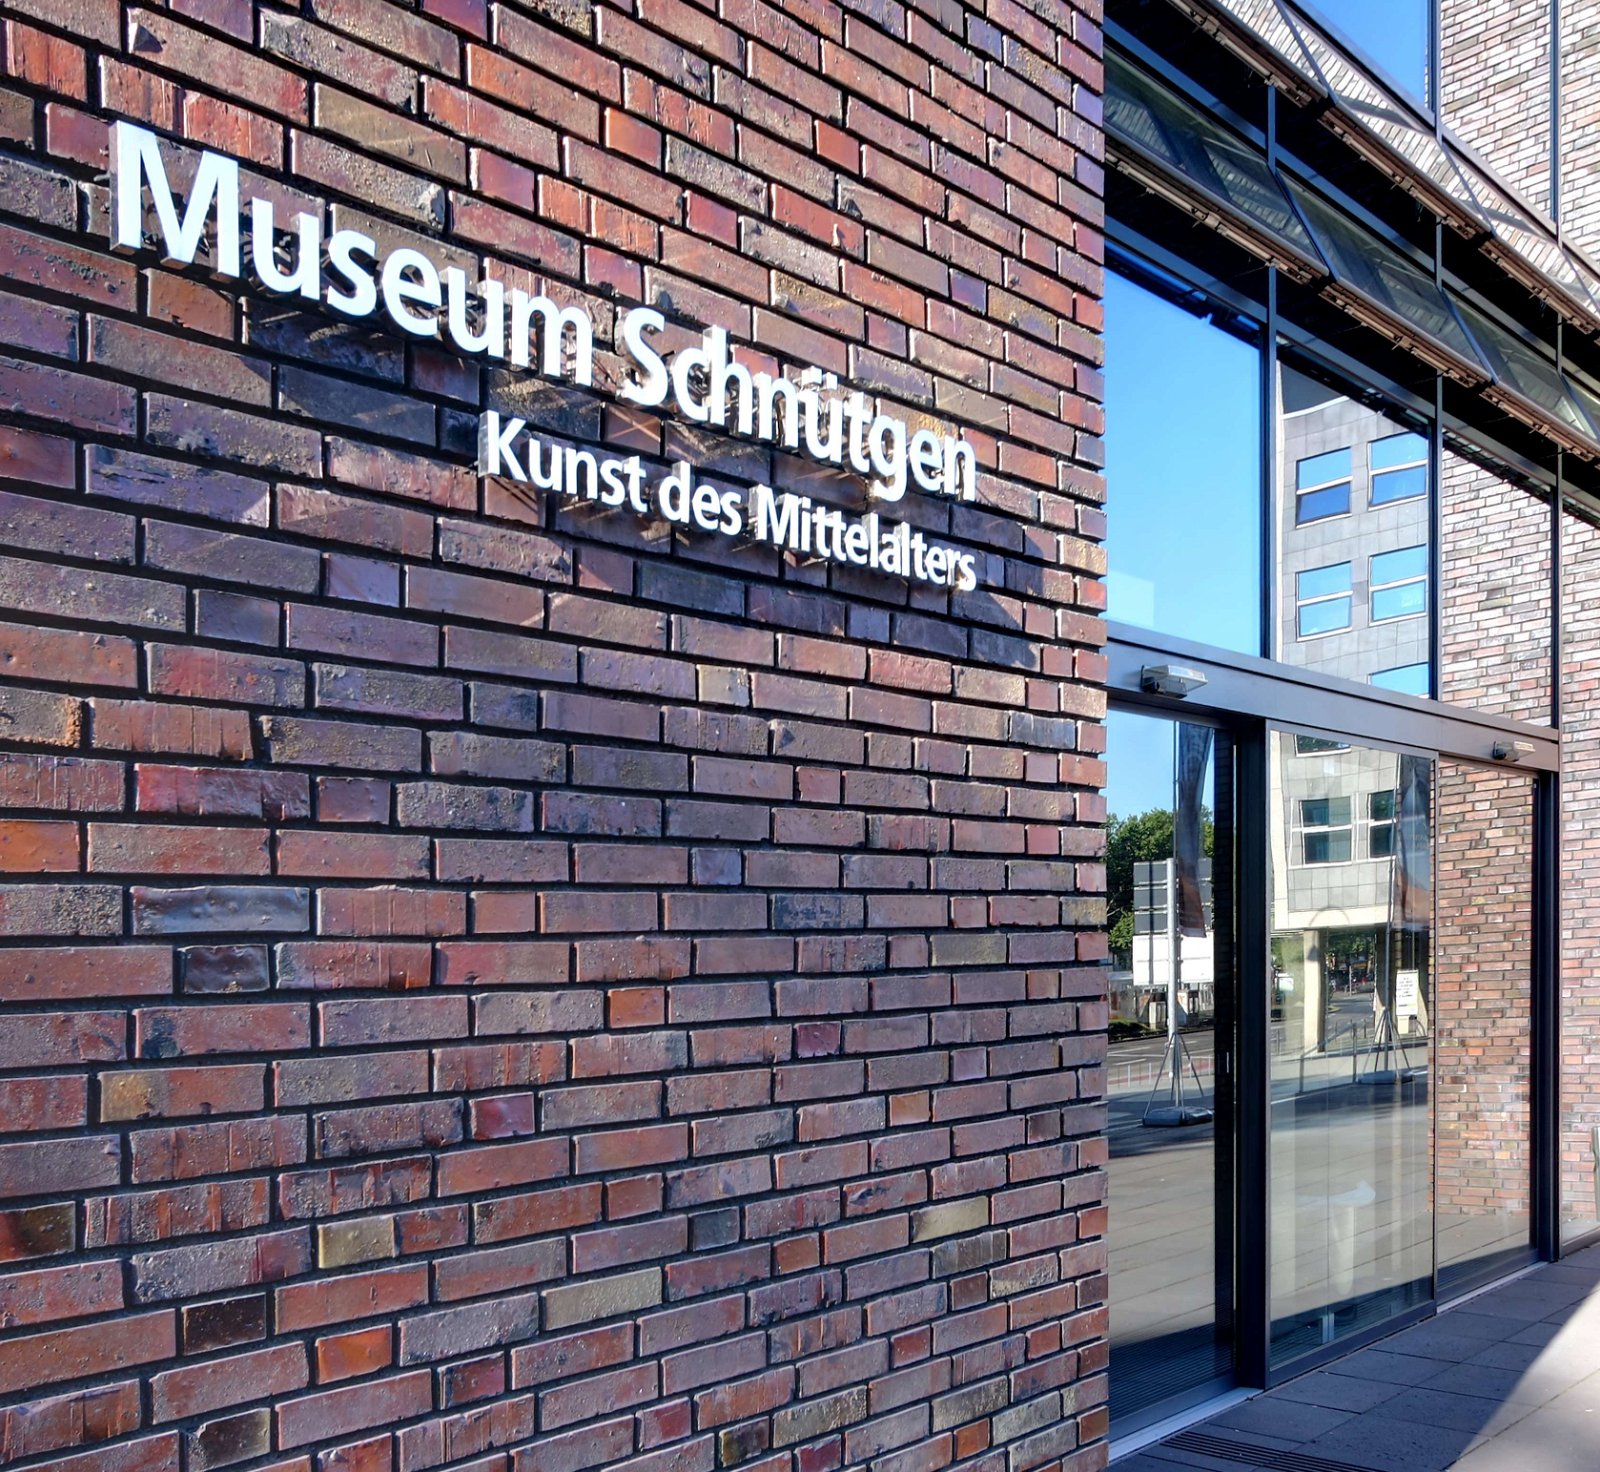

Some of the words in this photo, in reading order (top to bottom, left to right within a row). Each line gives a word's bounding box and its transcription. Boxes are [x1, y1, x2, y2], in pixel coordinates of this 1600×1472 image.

[111, 120, 593, 386] Museum
[616, 307, 977, 502] Schnütgen
[479, 410, 648, 513] Kunst
[657, 461, 743, 536] des
[753, 484, 977, 592] Mittelalters
